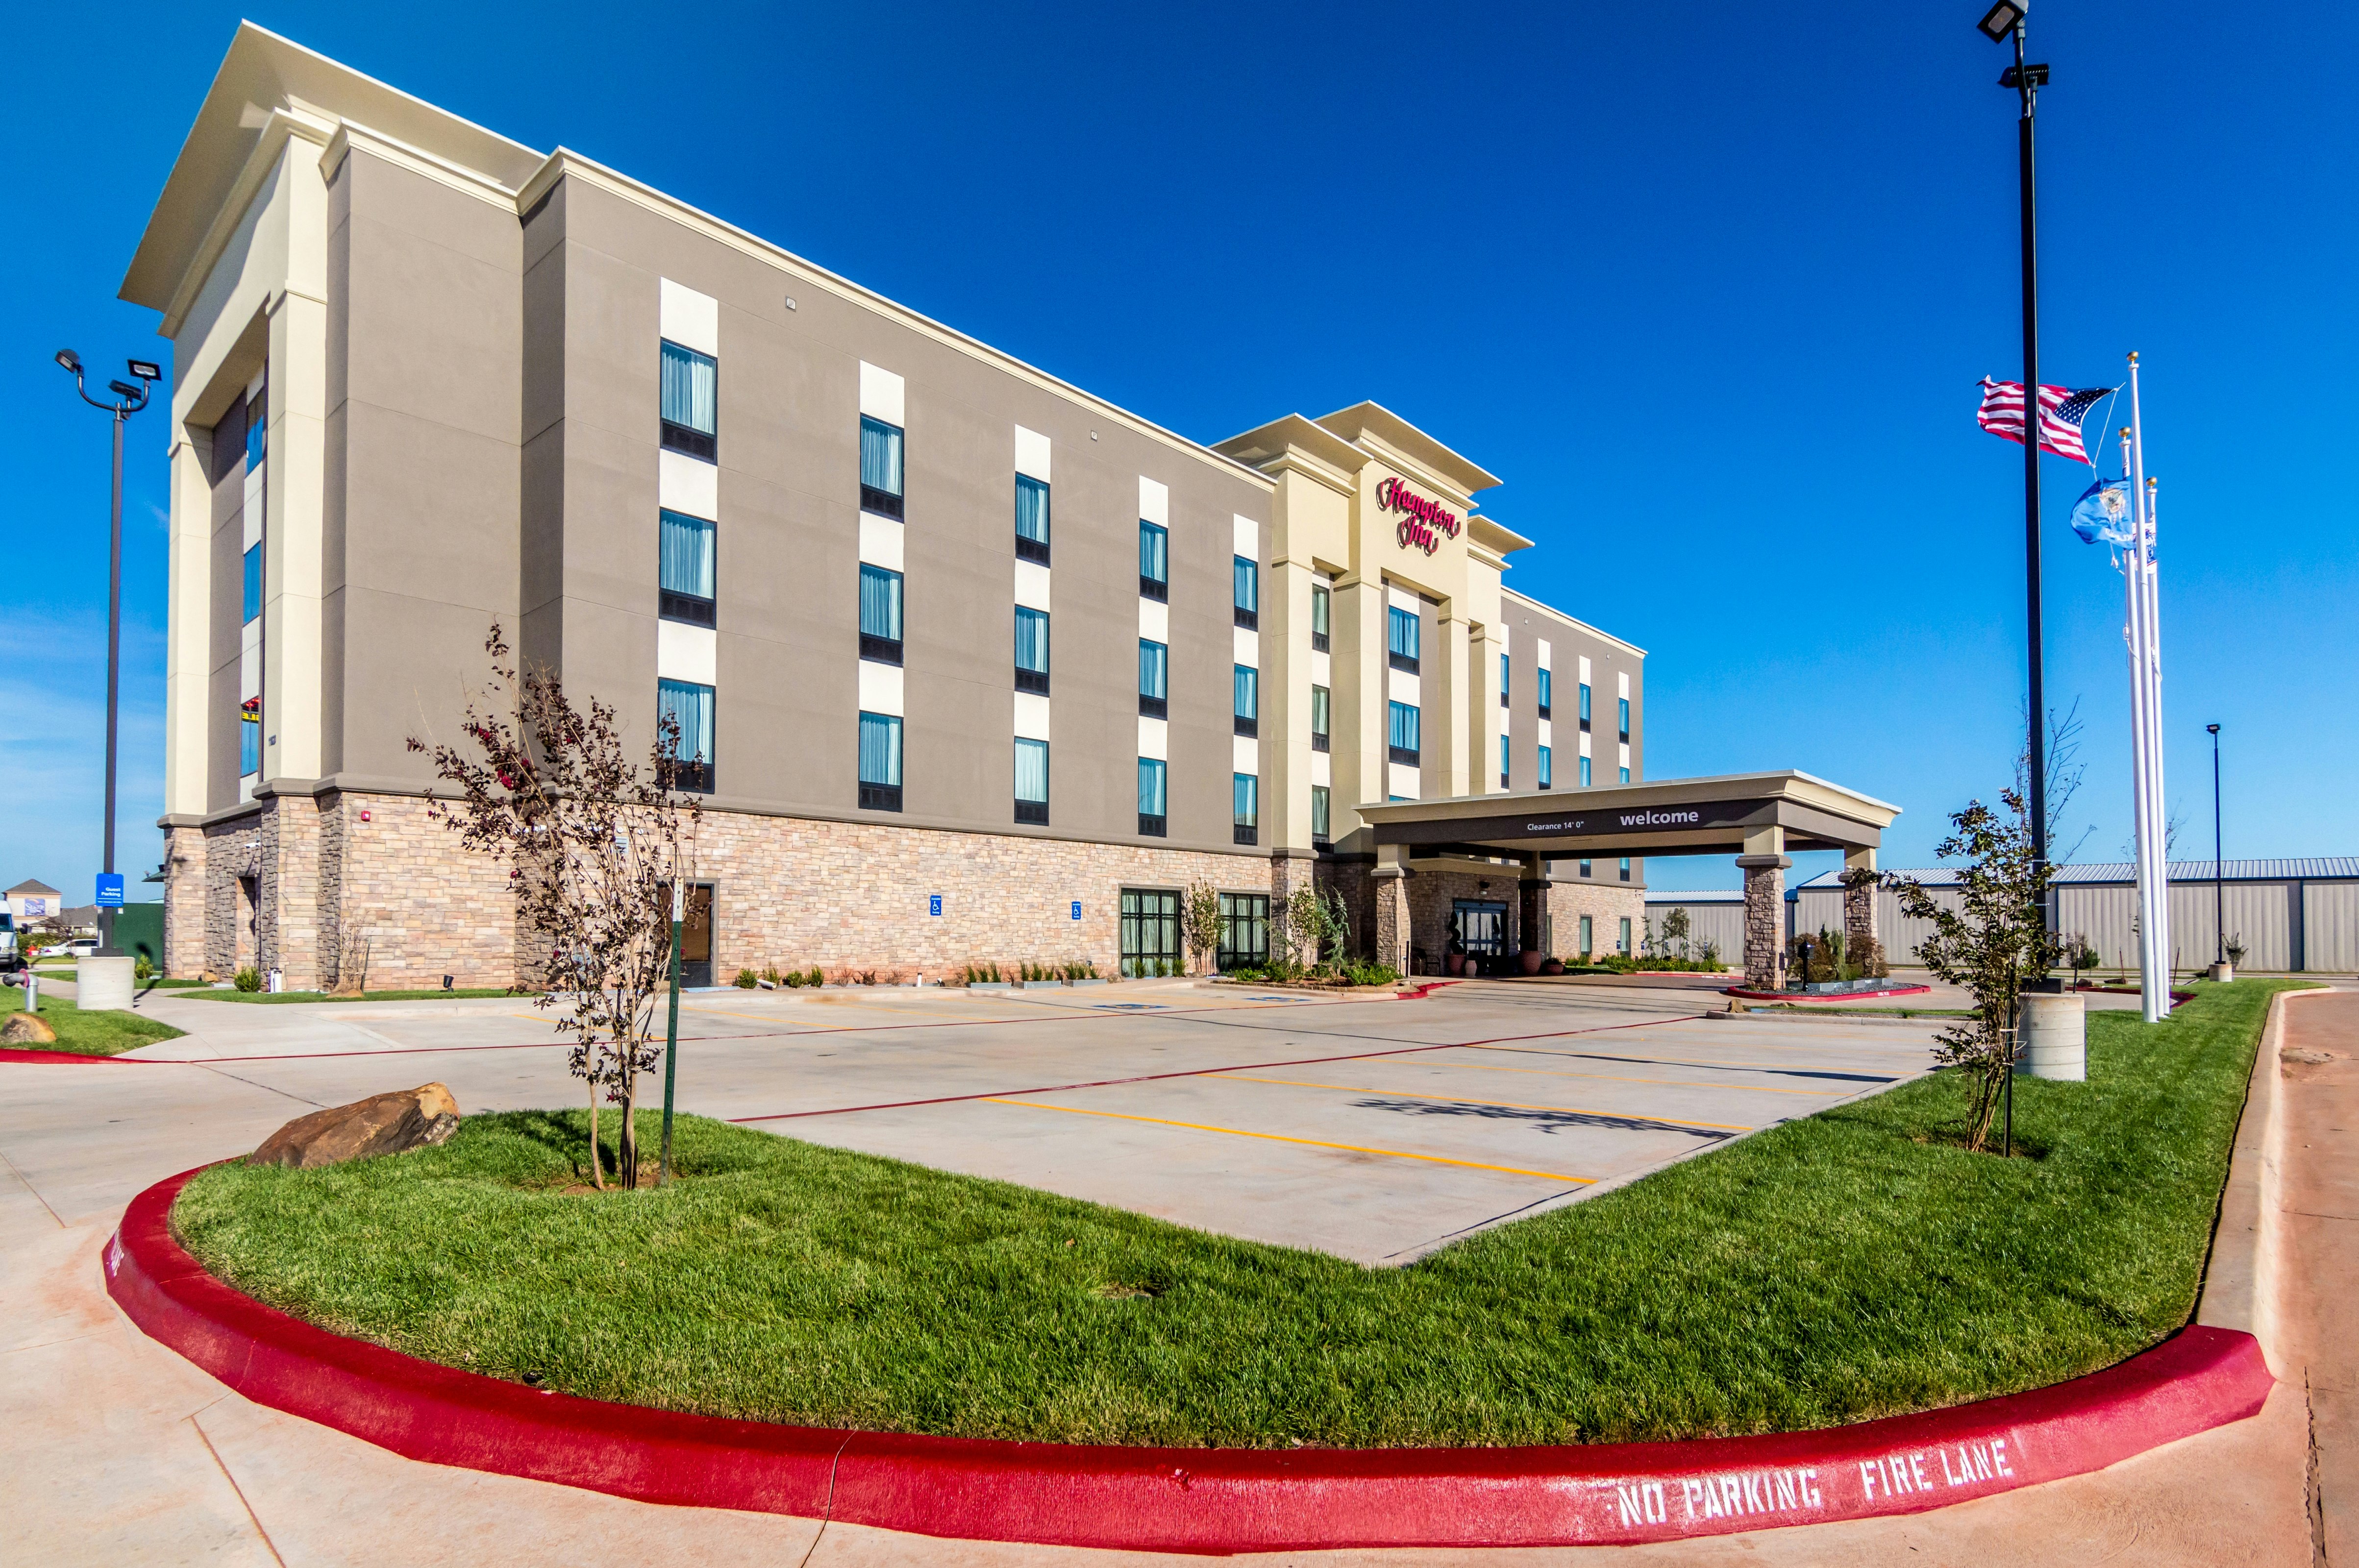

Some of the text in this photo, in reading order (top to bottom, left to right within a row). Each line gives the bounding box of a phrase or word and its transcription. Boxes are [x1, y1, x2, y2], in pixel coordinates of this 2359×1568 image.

[1379, 477, 1461, 537] Hampton
[1400, 515, 1439, 554] Inn
[1620, 810, 1698, 826] welcome
[1617, 1440, 2014, 1528] NO PARKING FIRE LANE
